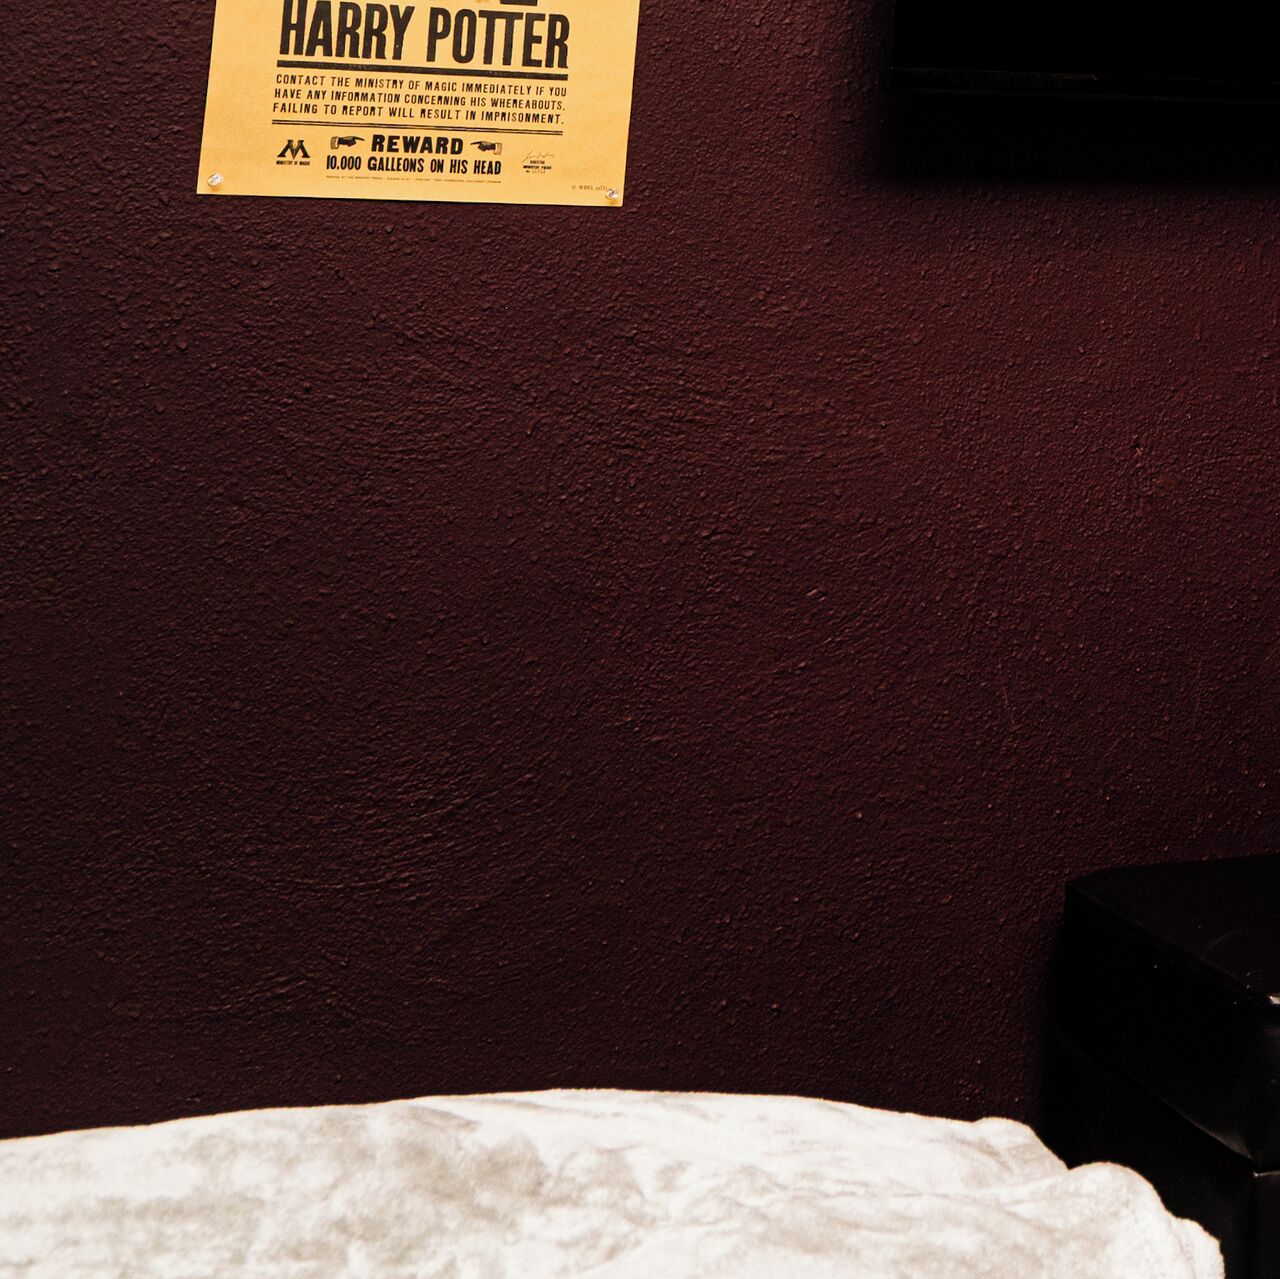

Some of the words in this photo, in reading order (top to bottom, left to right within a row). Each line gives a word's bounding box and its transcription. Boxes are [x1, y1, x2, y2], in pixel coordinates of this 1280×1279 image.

[426, 6, 570, 69] POTTER
[276, 73, 326, 86] CONTACT
[330, 76, 351, 88] THE
[354, 77, 404, 90] MINISTRY
[408, 80, 421, 90] OF
[424, 80, 457, 92] MAGIC
[461, 82, 532, 96] IMMEDIATELY
[535, 85, 545, 96] IF
[549, 86, 567, 97] YOU
[371, 134, 464, 155] REWARD
[367, 156, 425, 173] GALLEONS
[429, 158, 445, 174] ON
[449, 158, 469, 175] HIS
[473, 159, 502, 175] HEAD
